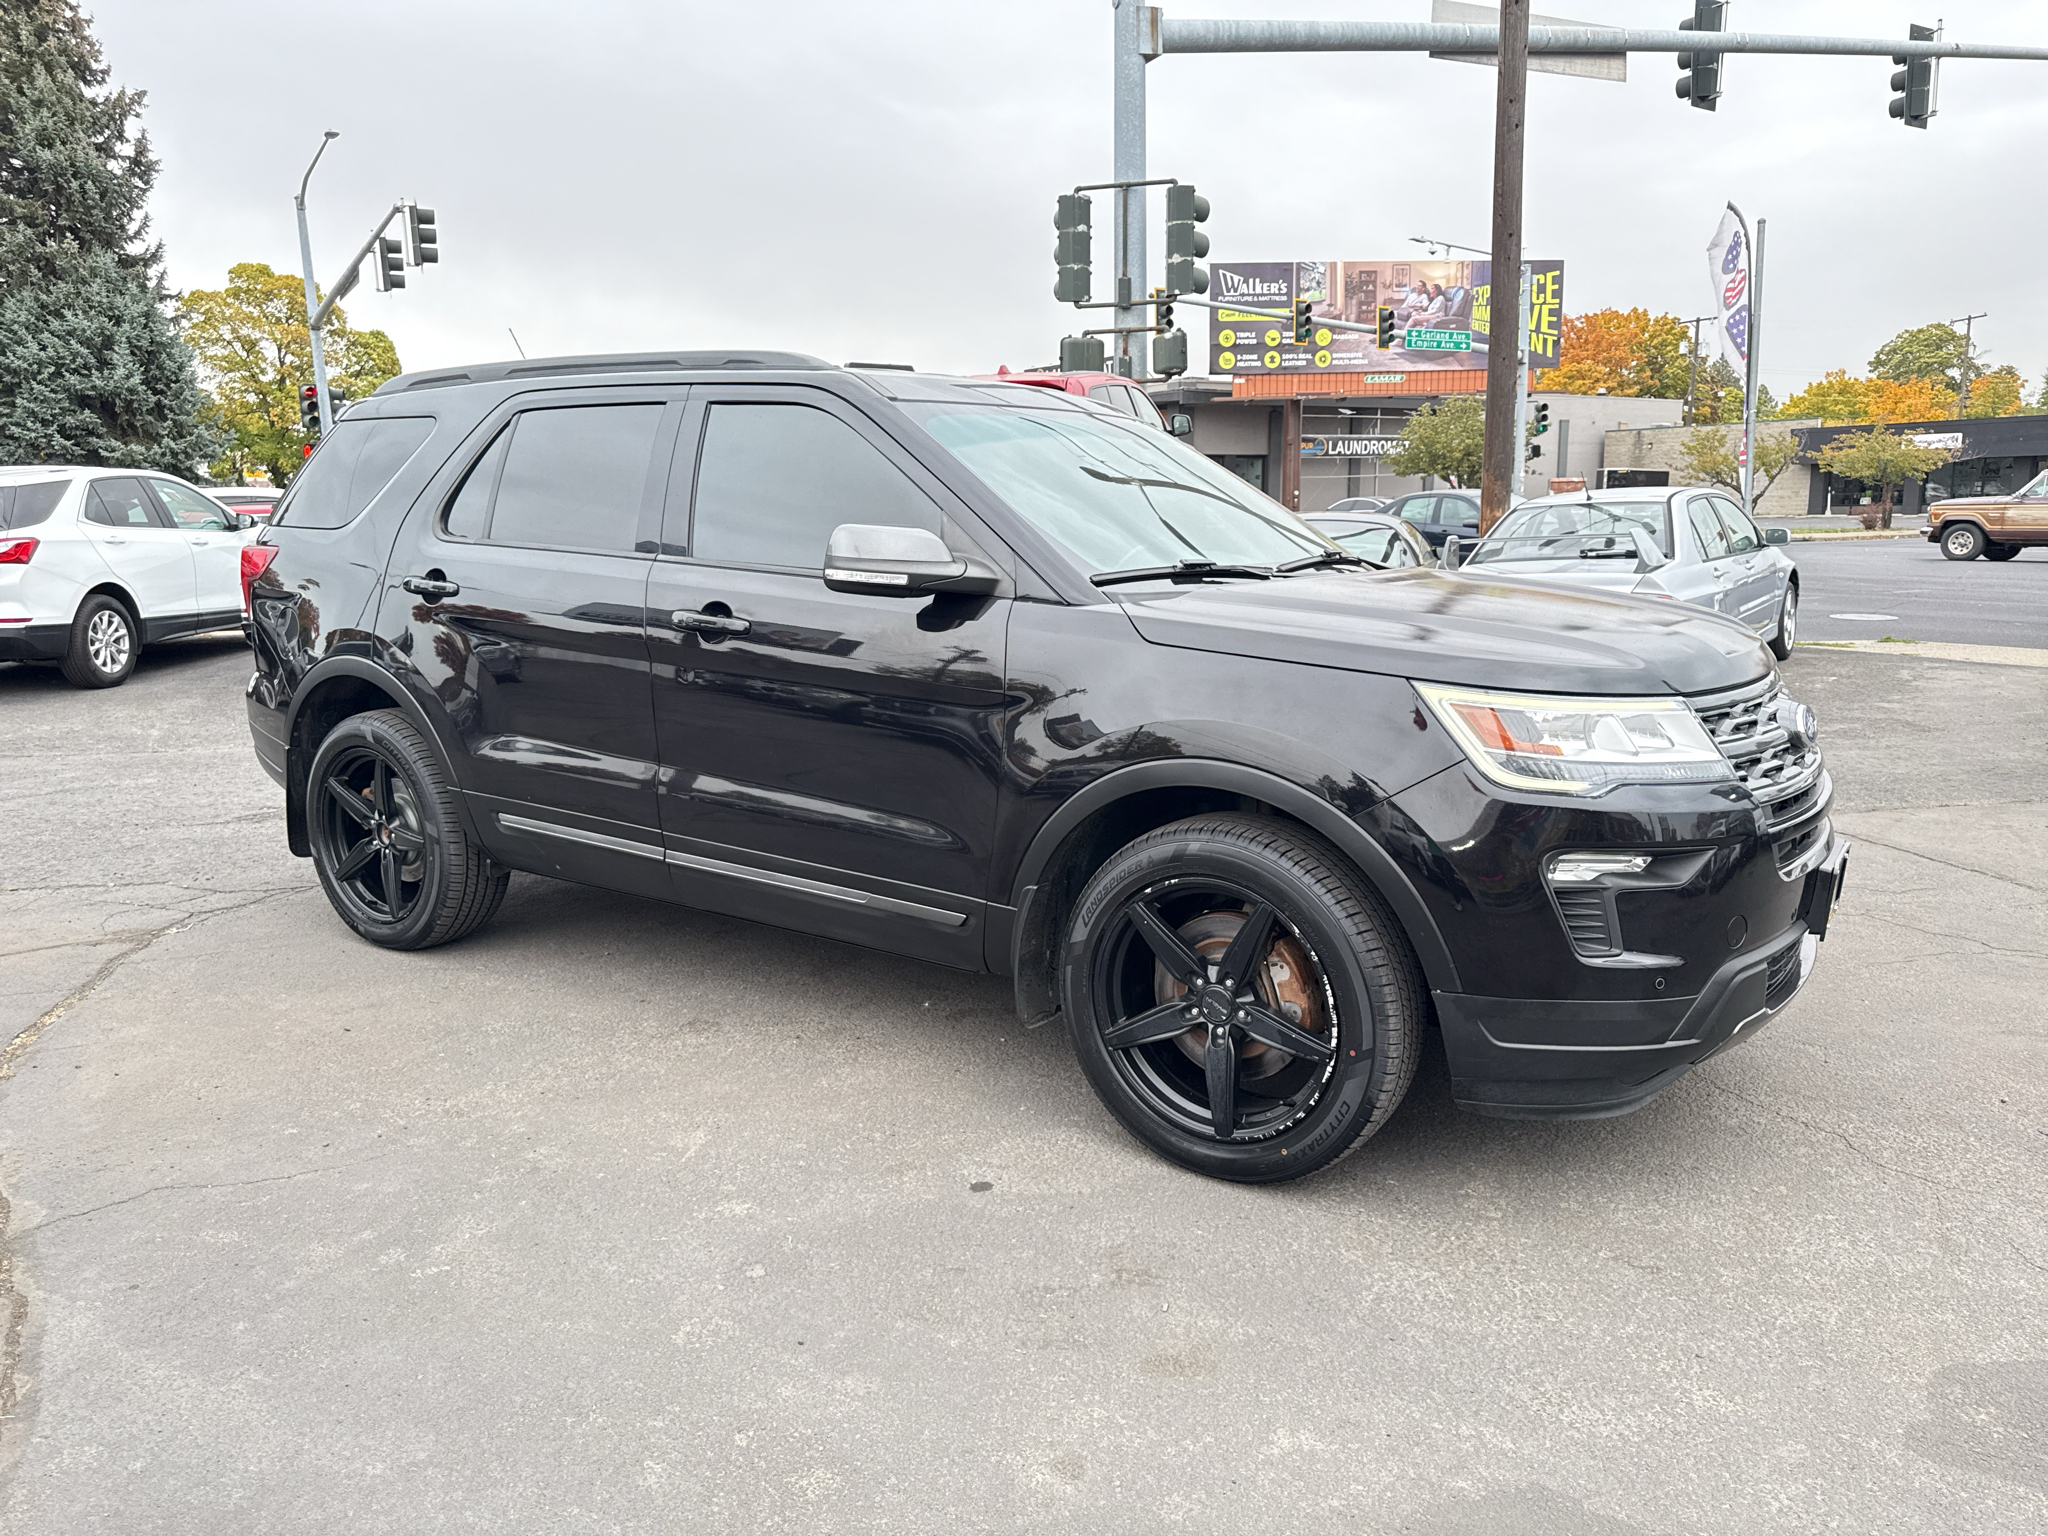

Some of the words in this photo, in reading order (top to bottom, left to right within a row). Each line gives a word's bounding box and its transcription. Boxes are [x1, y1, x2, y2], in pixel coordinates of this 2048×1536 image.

[1420, 330, 1449, 340] Garland
[1452, 332, 1468, 341] Ave.
[1411, 339, 1438, 349] Empire
[1440, 340, 1456, 349] Ave.
[1332, 358, 1369, 366] MULTI-MEDIA
[1366, 375, 1401, 383] LAMAR
[1081, 859, 1145, 928] LANDSPIDER
[1291, 1100, 1351, 1162] CITYTRAXX
